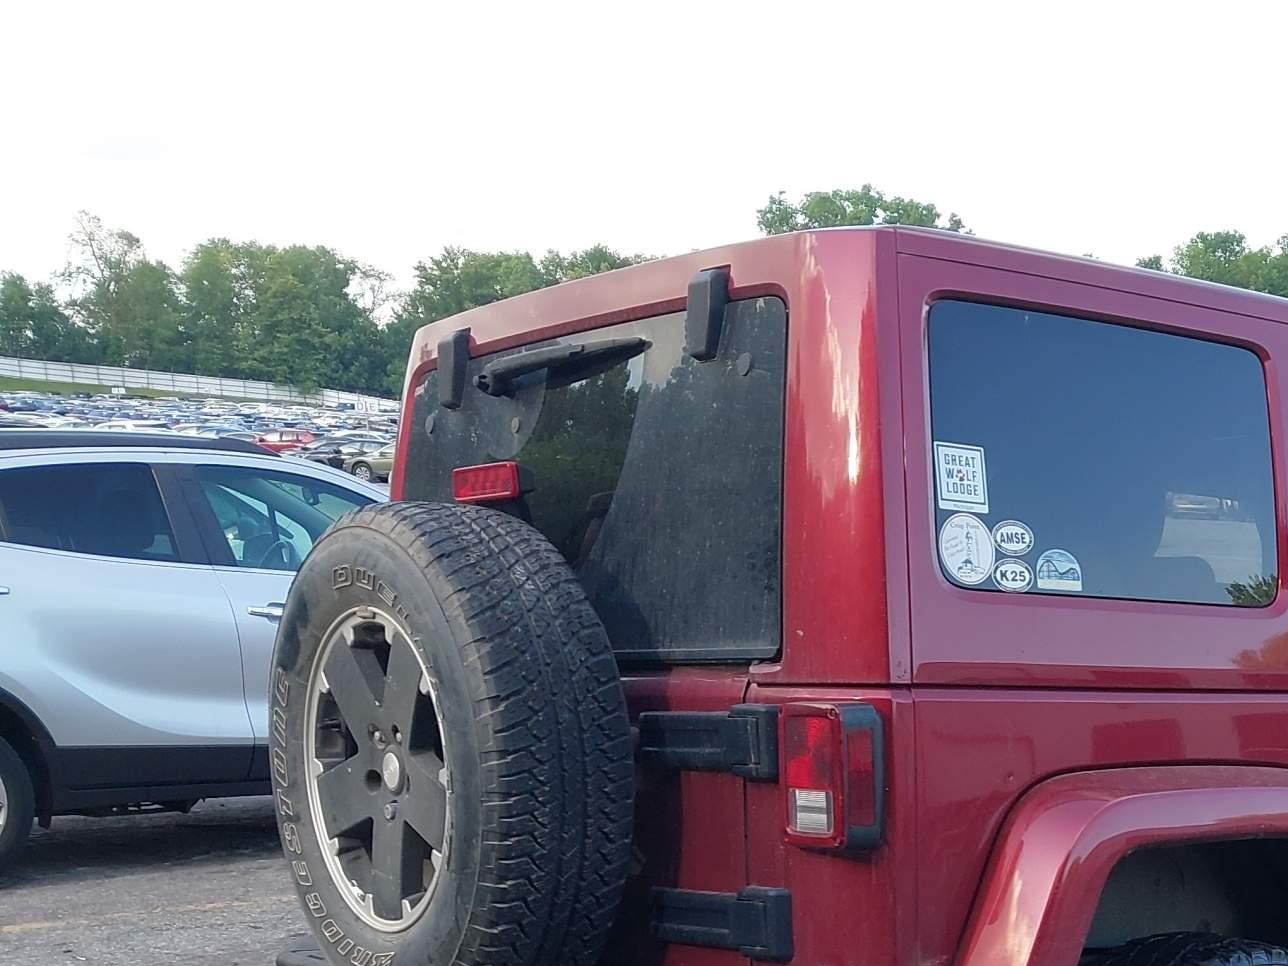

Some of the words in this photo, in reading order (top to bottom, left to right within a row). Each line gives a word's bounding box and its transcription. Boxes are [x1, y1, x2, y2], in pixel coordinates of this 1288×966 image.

[943, 453, 977, 468] GREAT
[945, 467, 977, 482] WLF
[946, 481, 980, 496] LODGE
[1000, 531, 1027, 545] AMSE
[999, 569, 1026, 582] K25
